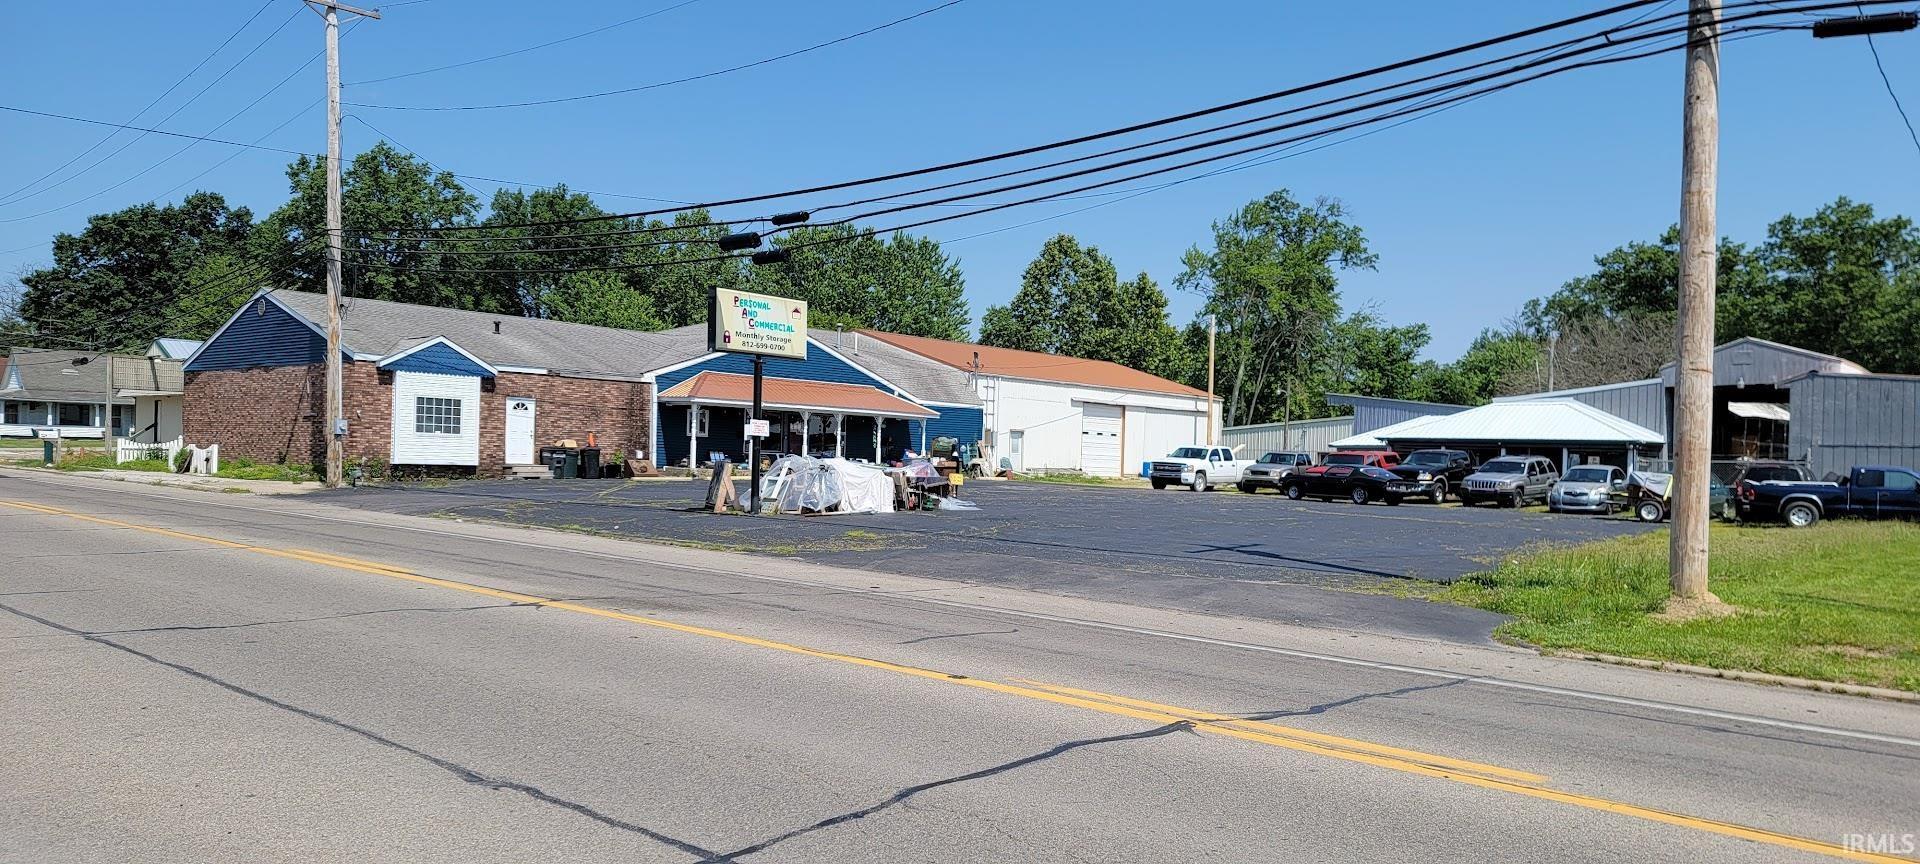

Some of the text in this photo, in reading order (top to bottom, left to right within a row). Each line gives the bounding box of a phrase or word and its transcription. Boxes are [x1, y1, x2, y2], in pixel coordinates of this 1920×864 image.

[733, 296, 771, 310] PERSONAL
[741, 308, 757, 318] AND
[748, 318, 795, 333] COMMERCIAL
[735, 331, 792, 344] Monthly Storage
